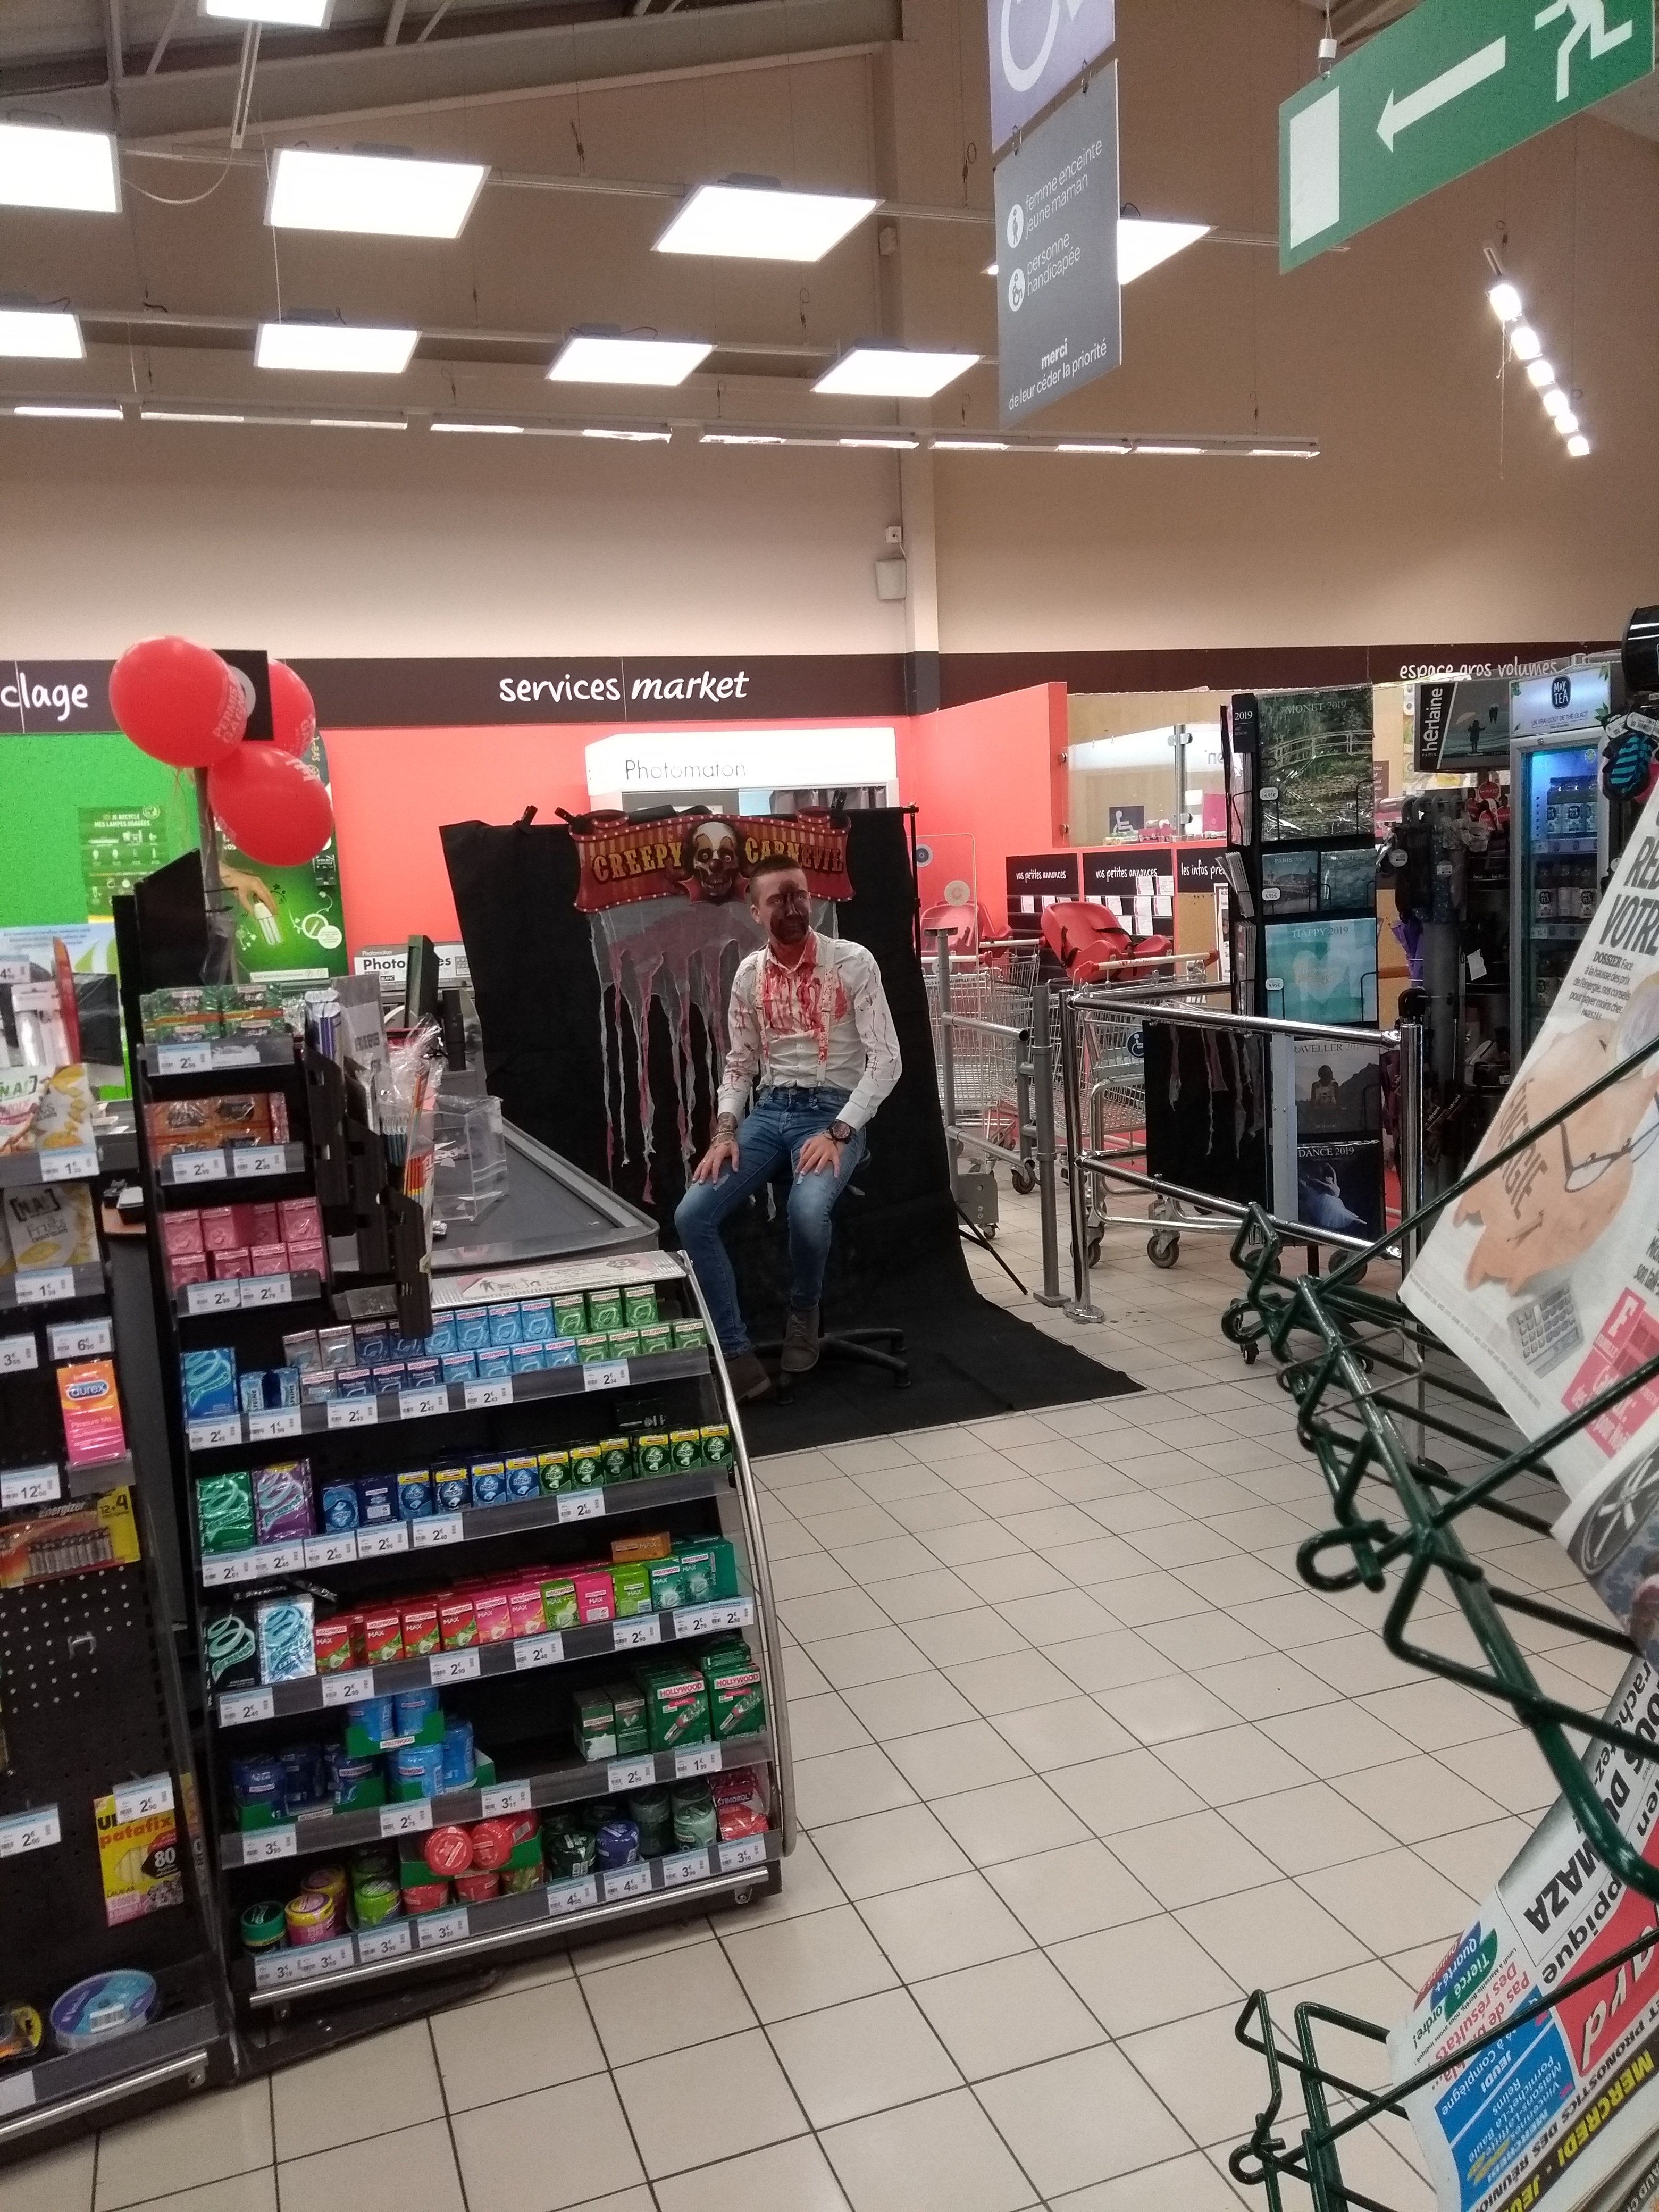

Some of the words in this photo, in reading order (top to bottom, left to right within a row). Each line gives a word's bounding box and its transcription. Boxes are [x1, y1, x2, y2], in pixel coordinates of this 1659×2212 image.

[1025, 177, 1058, 213] femme
[1059, 140, 1102, 185] enceinte
[1025, 205, 1050, 240] jeune
[1052, 174, 1088, 213] maman
[1027, 233, 1069, 275] personne
[1027, 246, 1080, 296] handicapée
[1041, 338, 1068, 369] merci
[1009, 394, 1019, 410] de
[1020, 386, 1035, 404] leur
[1037, 370, 1061, 393] céder
[1063, 363, 1070, 379] la
[1072, 338, 1107, 377] priorité
[1400, 664, 1454, 680] espace
[1498, 655, 1557, 676] volumes
[0, 672, 88, 722] clage
[499, 674, 621, 702] services
[631, 671, 750, 702] market
[1554, 680, 1566, 693] MAY
[1554, 689, 1569, 705] TEA
[1234, 710, 1253, 721] 2019
[1286, 702, 1325, 715] MONET
[1327, 700, 1347, 711] 2019
[1422, 687, 1444, 752] herlaine
[625, 759, 746, 780] Photomaton
[592, 841, 683, 882] CREEPY
[1180, 862, 1191, 877] les
[1191, 859, 1209, 877] infos
[1016, 871, 1025, 881] vos
[1025, 869, 1042, 884] petites
[1043, 868, 1067, 880] annonces
[1095, 869, 1105, 879] vos
[1106, 867, 1128, 882] petites
[1129, 867, 1158, 877] annonces
[1292, 927, 1327, 939] HAPPY
[1328, 926, 1349, 935] 2019
[1592, 951, 1623, 968] DOSSIER
[1621, 958, 1634, 971] Face
[1294, 1043, 1343, 1054] RAVELLER
[1298, 1148, 1333, 1158] DANCE
[1335, 1146, 1355, 1156] 2019
[70, 1382, 106, 1397] durex
[707, 1443, 725, 1452] FRESH
[545, 1471, 564, 1479] FRESH
[444, 1488, 463, 1497] FRESH
[38, 1501, 87, 1519] Energizer
[682, 1554, 709, 1563] HOLLYWOOD
[653, 1566, 680, 1576] HOLLYWOOD
[547, 1586, 574, 1597] HOLLYWOOD
[442, 1604, 473, 1616] HOLLYWOOD
[659, 1682, 703, 1698] HOLLYWOOD
[716, 1673, 759, 1689] HOLLYWOOD
[381, 1736, 415, 1748] HOLLYWOOD
[716, 1792, 752, 1807] STIMOROL
[98, 1814, 173, 1850] patafix
[154, 1846, 177, 1868] 80
[1435, 1937, 1478, 1993] Quarté+
[1504, 1947, 1518, 1966] Lundi
[1454, 1953, 1490, 2000] Tiercé
[1492, 1961, 1518, 1996] Des
[1506, 1970, 1530, 2005] Pas
[1448, 2012, 1461, 2026] nous
[1488, 2001, 1505, 2026] de
[1413, 2004, 1443, 2050] ordre!
[1434, 2025, 1449, 2042] avons
[1435, 1992, 1492, 2062] résultats
[1480, 2050, 1512, 2093] JEUDI
[1561, 2019, 1645, 2125] PRONOSTICS
[1441, 2050, 1496, 2116] Compiègne
[1495, 2055, 1554, 2129] Pornichet-La
[1492, 2078, 1521, 2116] Reims
[1556, 2048, 1655, 2167] MERCREDI
[1468, 2127, 1494, 2163] Baule
[1532, 2123, 1559, 2159] DES
